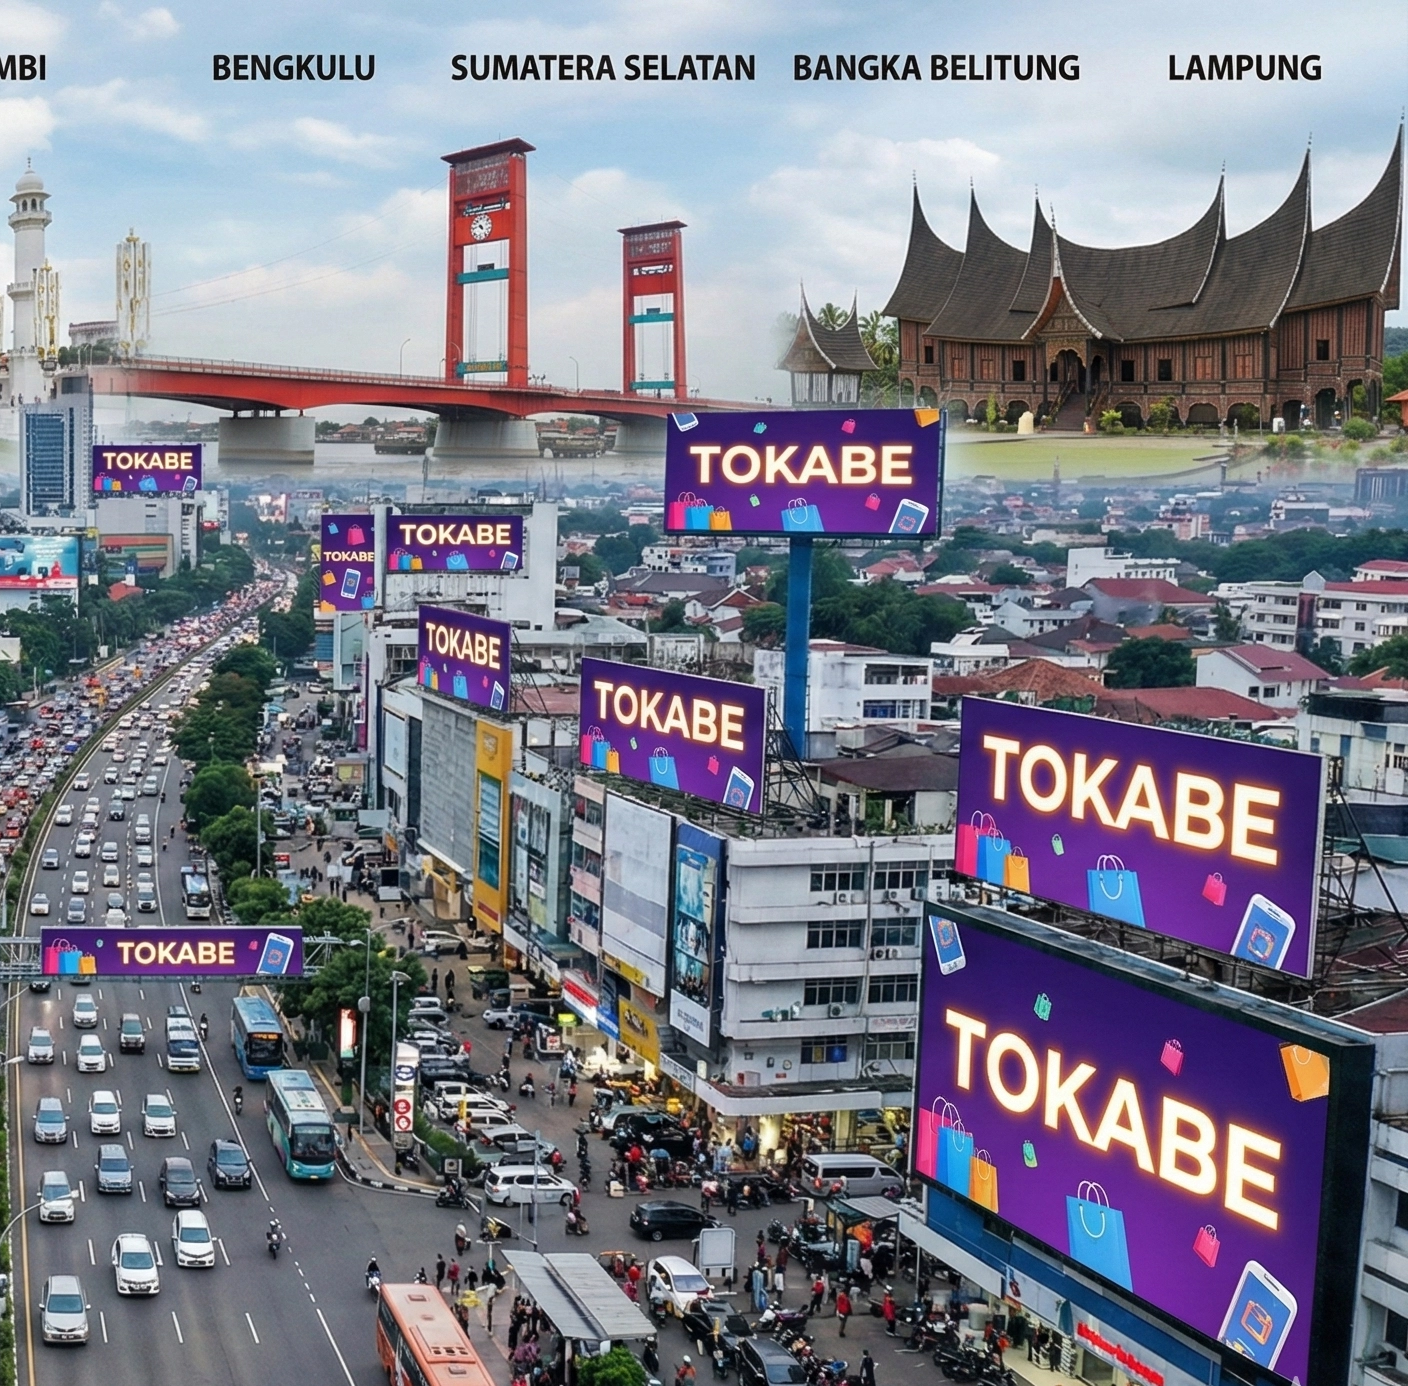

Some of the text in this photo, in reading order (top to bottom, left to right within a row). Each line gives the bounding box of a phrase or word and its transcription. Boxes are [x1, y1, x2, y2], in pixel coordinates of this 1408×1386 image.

[102, 452, 193, 470] TOKABE
[689, 445, 913, 485] TOKABE
[399, 524, 511, 545] TOKABE
[323, 551, 375, 562] TOKABE
[425, 622, 501, 670] TOKABE
[594, 680, 744, 751] TOKABE
[983, 735, 1280, 866] TOKABE
[117, 941, 235, 965] TOKABE
[945, 1008, 1281, 1231] TOKABE
